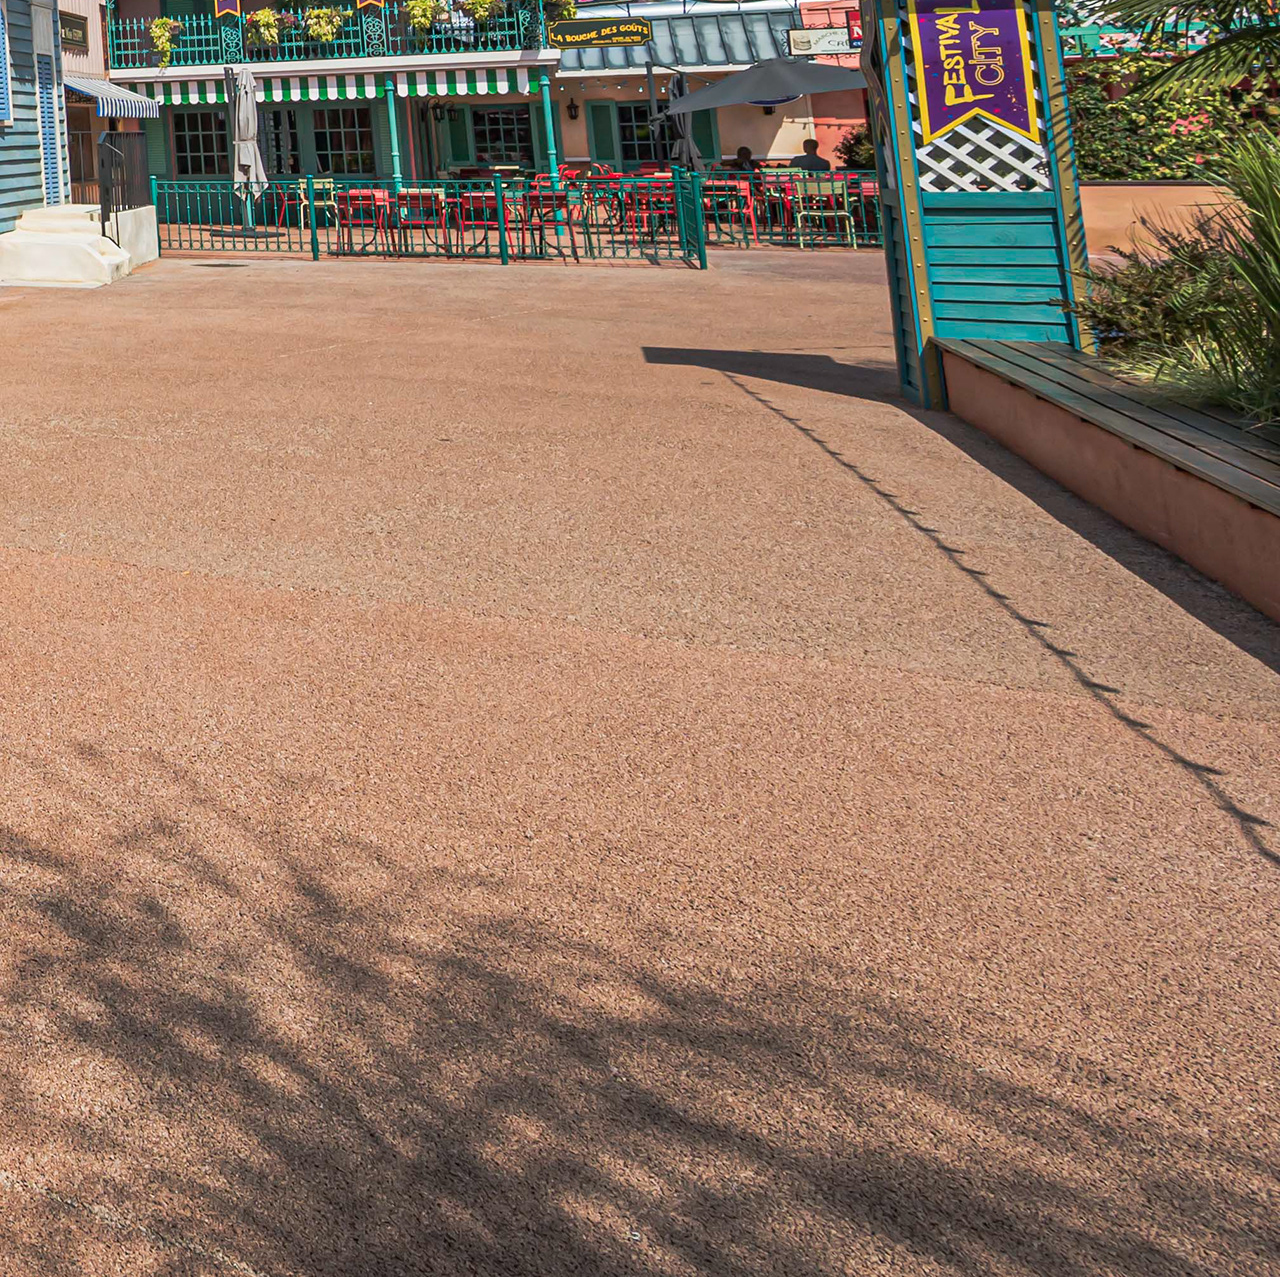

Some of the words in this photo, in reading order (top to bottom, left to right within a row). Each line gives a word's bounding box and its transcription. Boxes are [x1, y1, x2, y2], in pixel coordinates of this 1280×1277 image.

[550, 32, 563, 42] LA
[565, 31, 598, 42] BOUCHE
[601, 25, 618, 36] DES
[969, 21, 1005, 86] CITY
